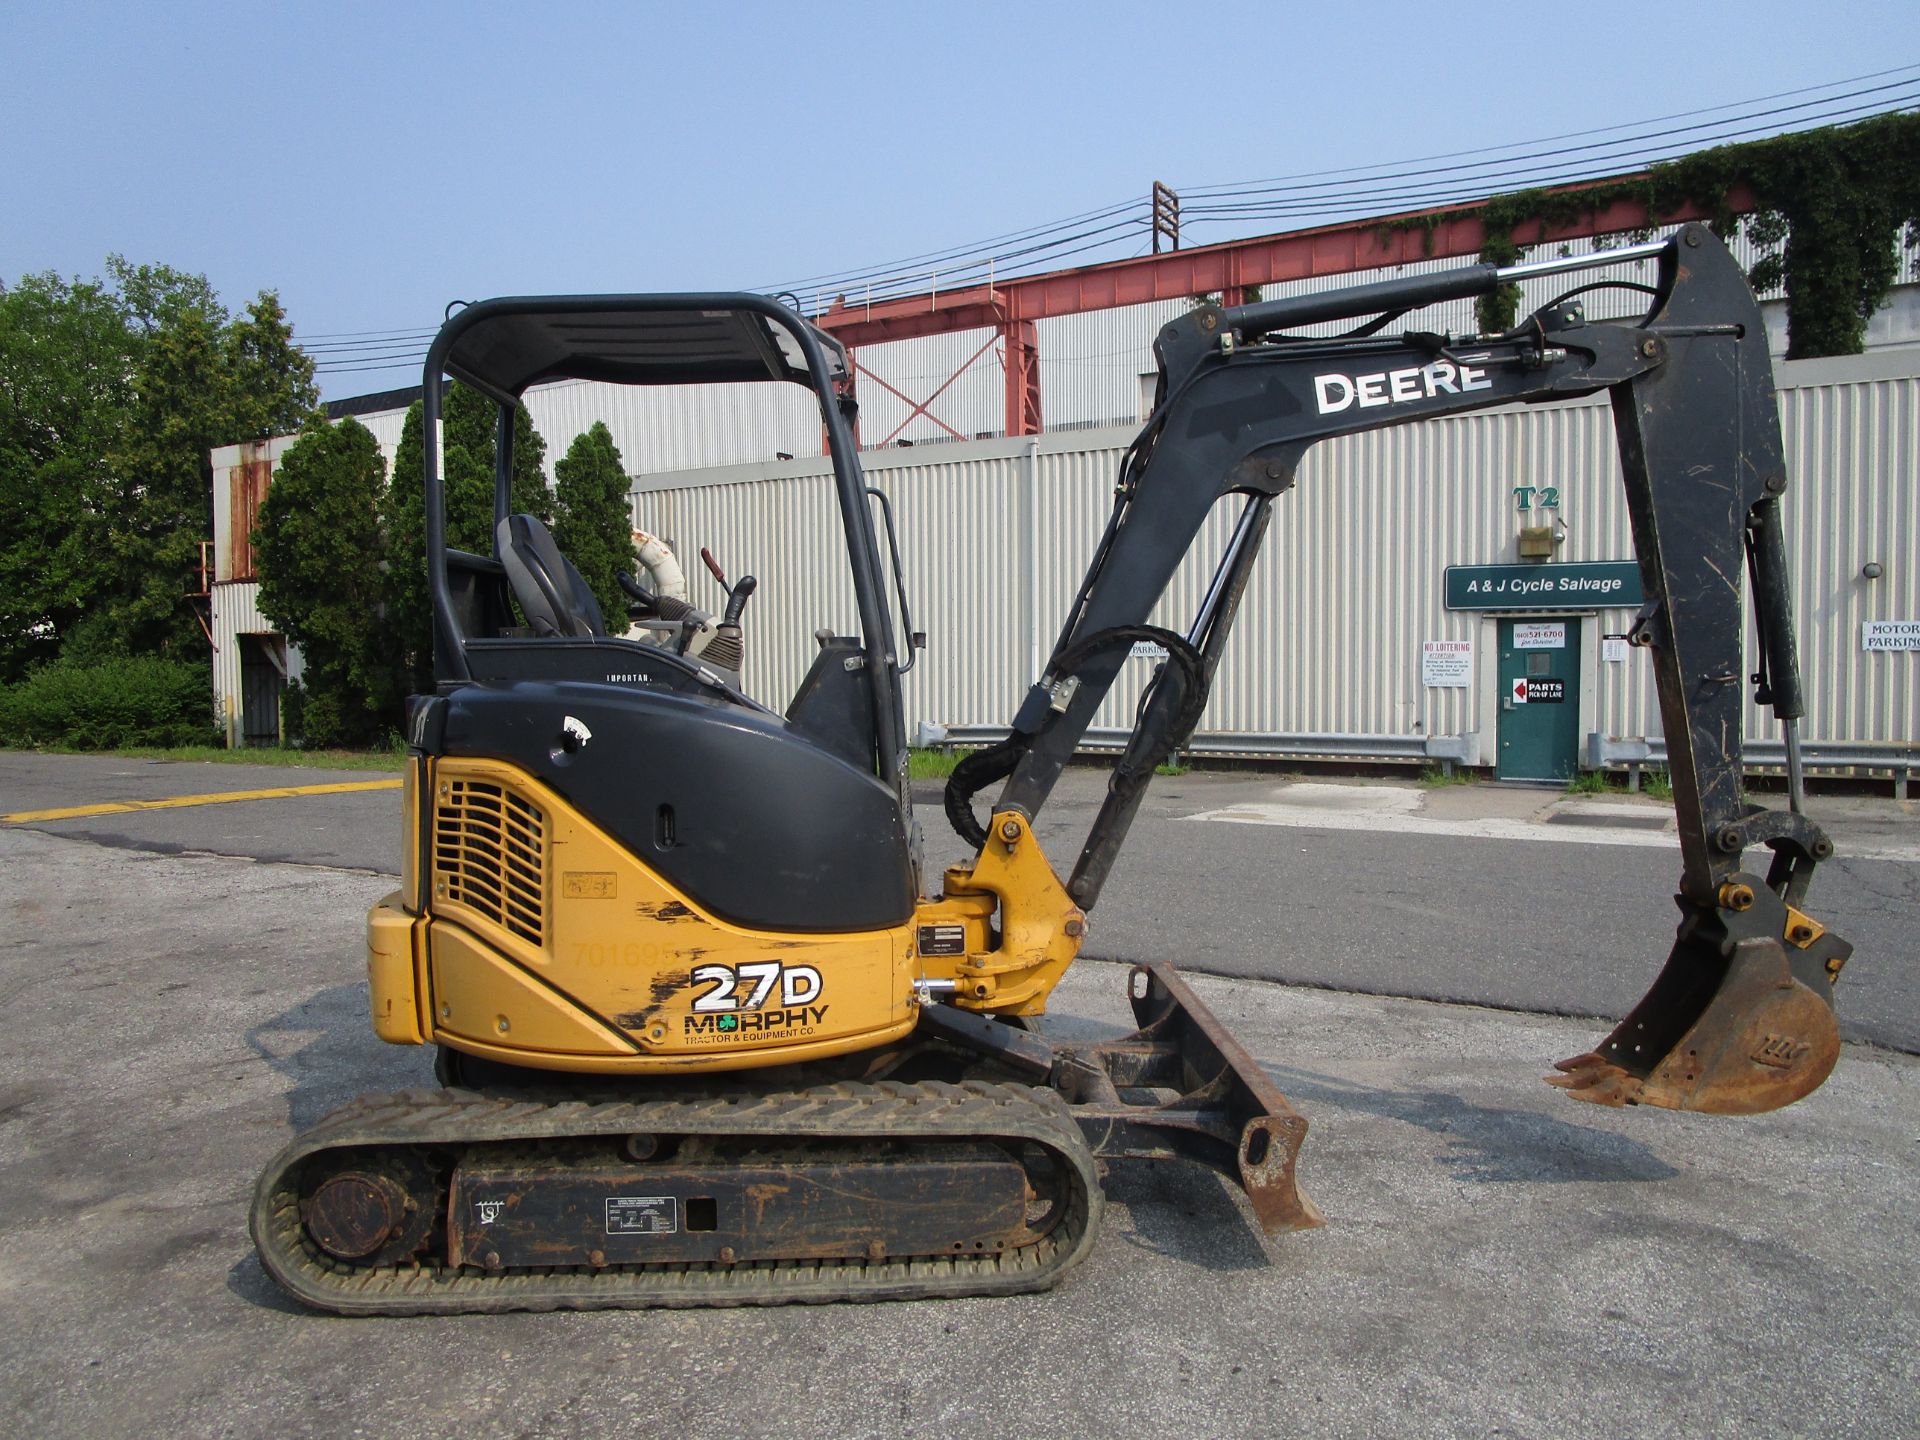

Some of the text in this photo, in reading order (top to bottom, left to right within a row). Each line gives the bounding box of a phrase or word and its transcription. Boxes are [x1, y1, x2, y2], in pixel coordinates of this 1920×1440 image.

[1314, 352, 1492, 415] DEERE
[1467, 575, 1622, 595] A & J Cycle Salvage
[1424, 643, 1470, 652] NO LOITERING
[1529, 683, 1562, 691] PARTS
[691, 960, 823, 1014] 27D
[685, 1026, 816, 1044] TRACTOR & EQUIPMENT CO.
